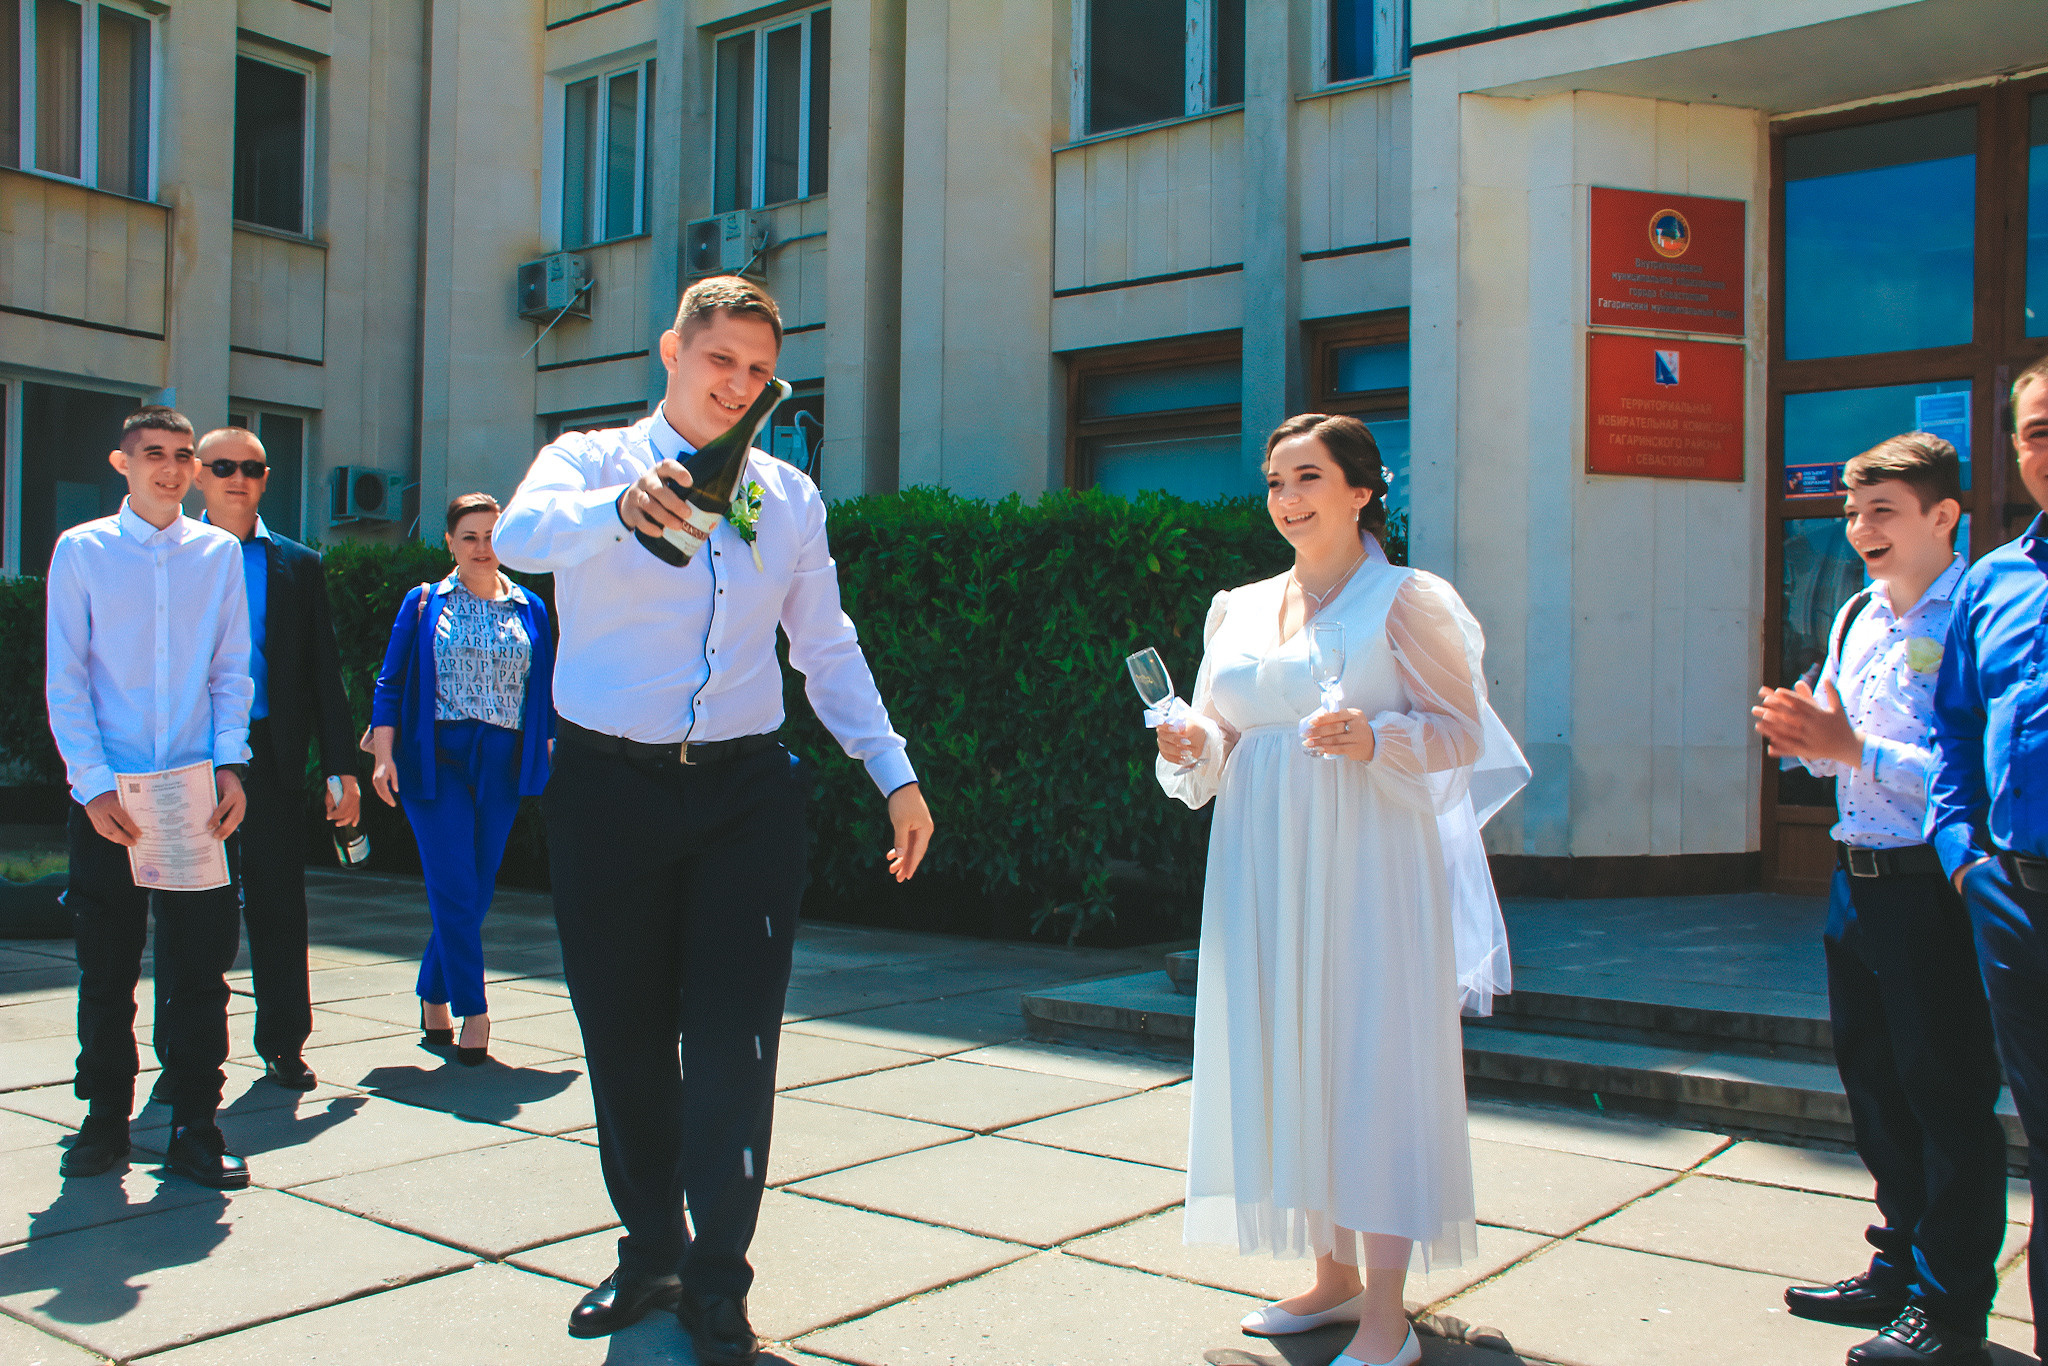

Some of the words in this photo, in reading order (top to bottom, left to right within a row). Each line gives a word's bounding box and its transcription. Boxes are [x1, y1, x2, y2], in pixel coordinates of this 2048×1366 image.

[1598, 298, 1649, 311] Гагаринский
[1621, 397, 1712, 414] ТЕРРИТОРИАЛЬНАЯ
[1598, 415, 1678, 430] ИЗБИРАТЕЛЬНАЯ
[1609, 433, 1683, 448] ГАГАРИНСКОГО
